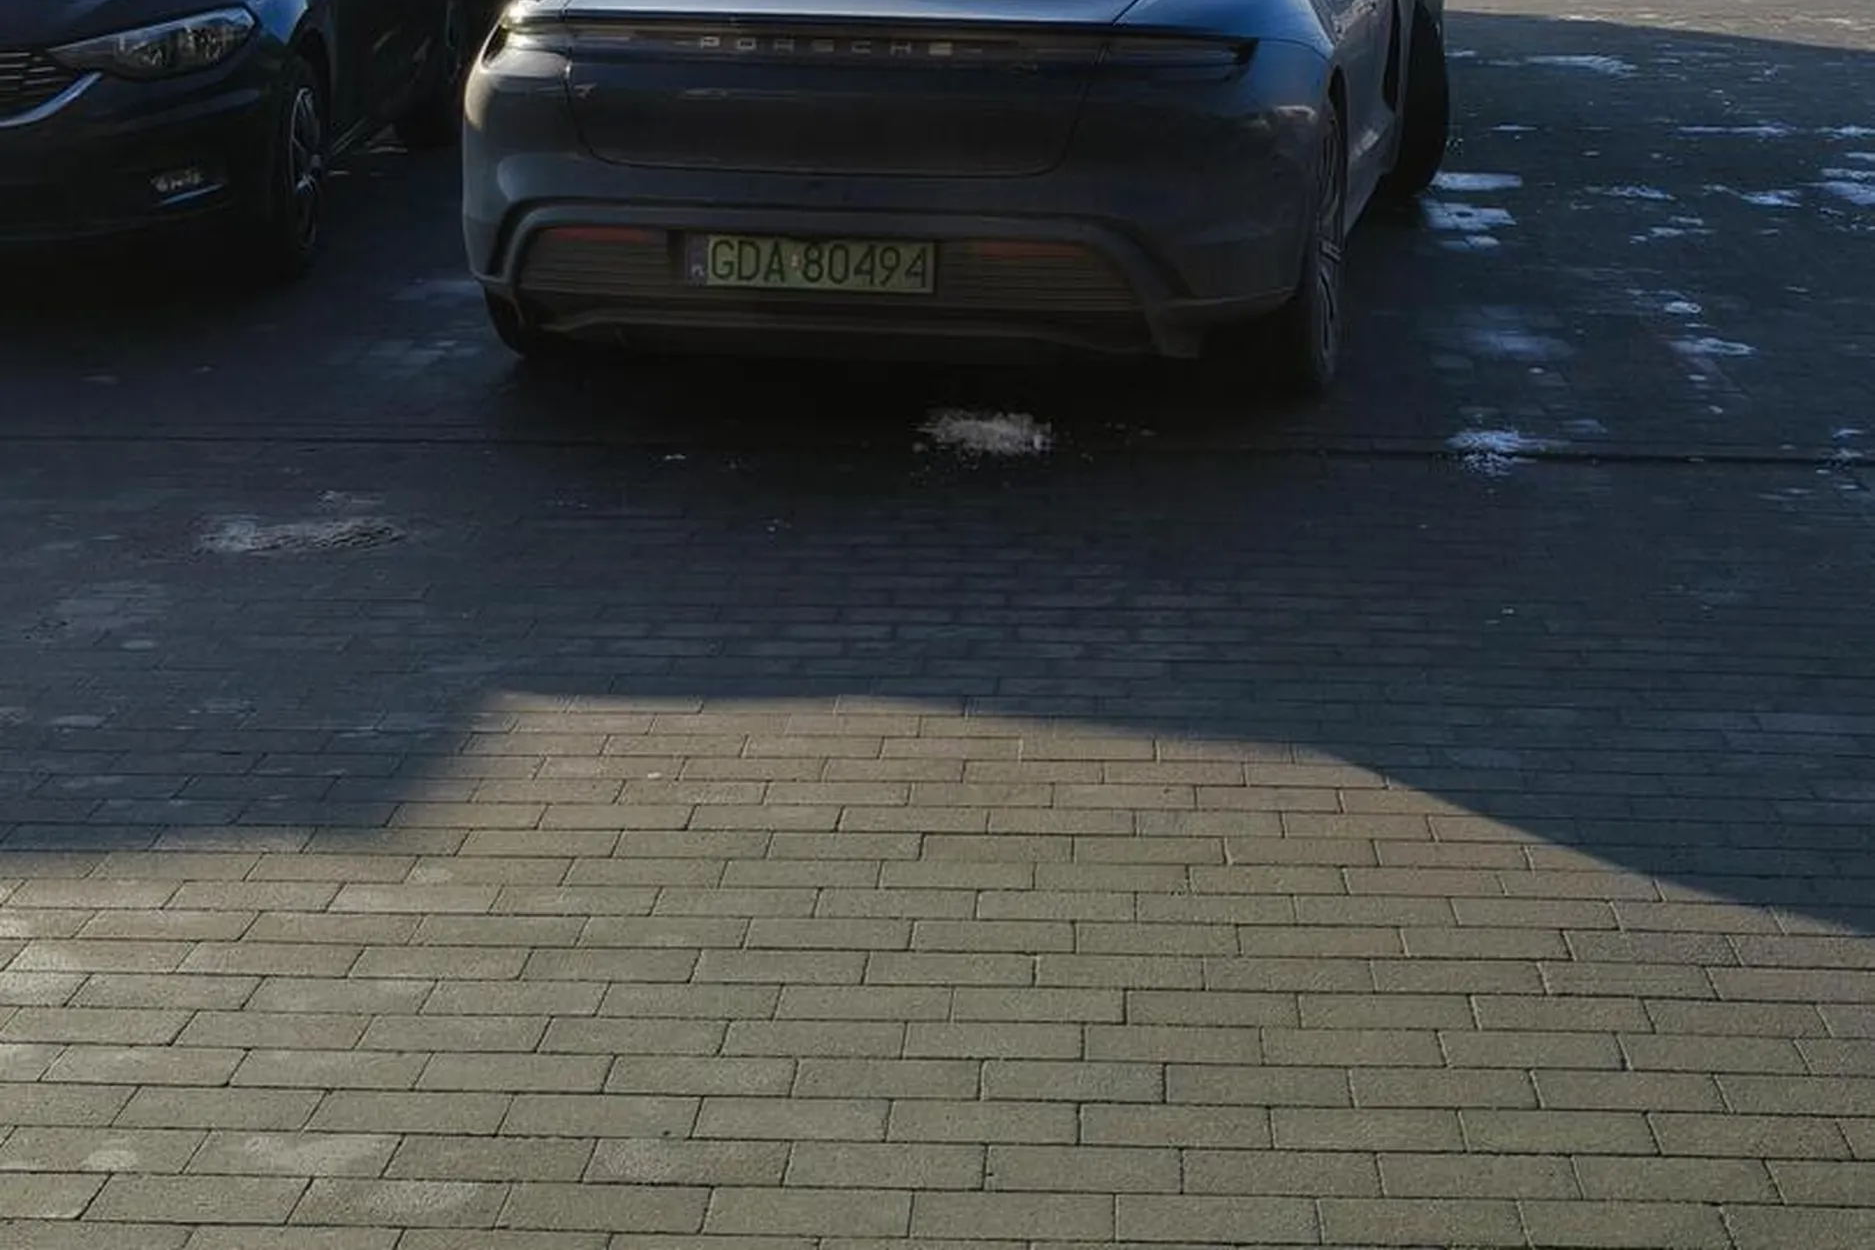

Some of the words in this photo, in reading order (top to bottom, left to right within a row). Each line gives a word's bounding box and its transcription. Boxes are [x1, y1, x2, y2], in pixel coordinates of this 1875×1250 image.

[700, 37, 953, 56] PORSCHE
[713, 239, 786, 282] GDA
[802, 241, 927, 290] 80494
